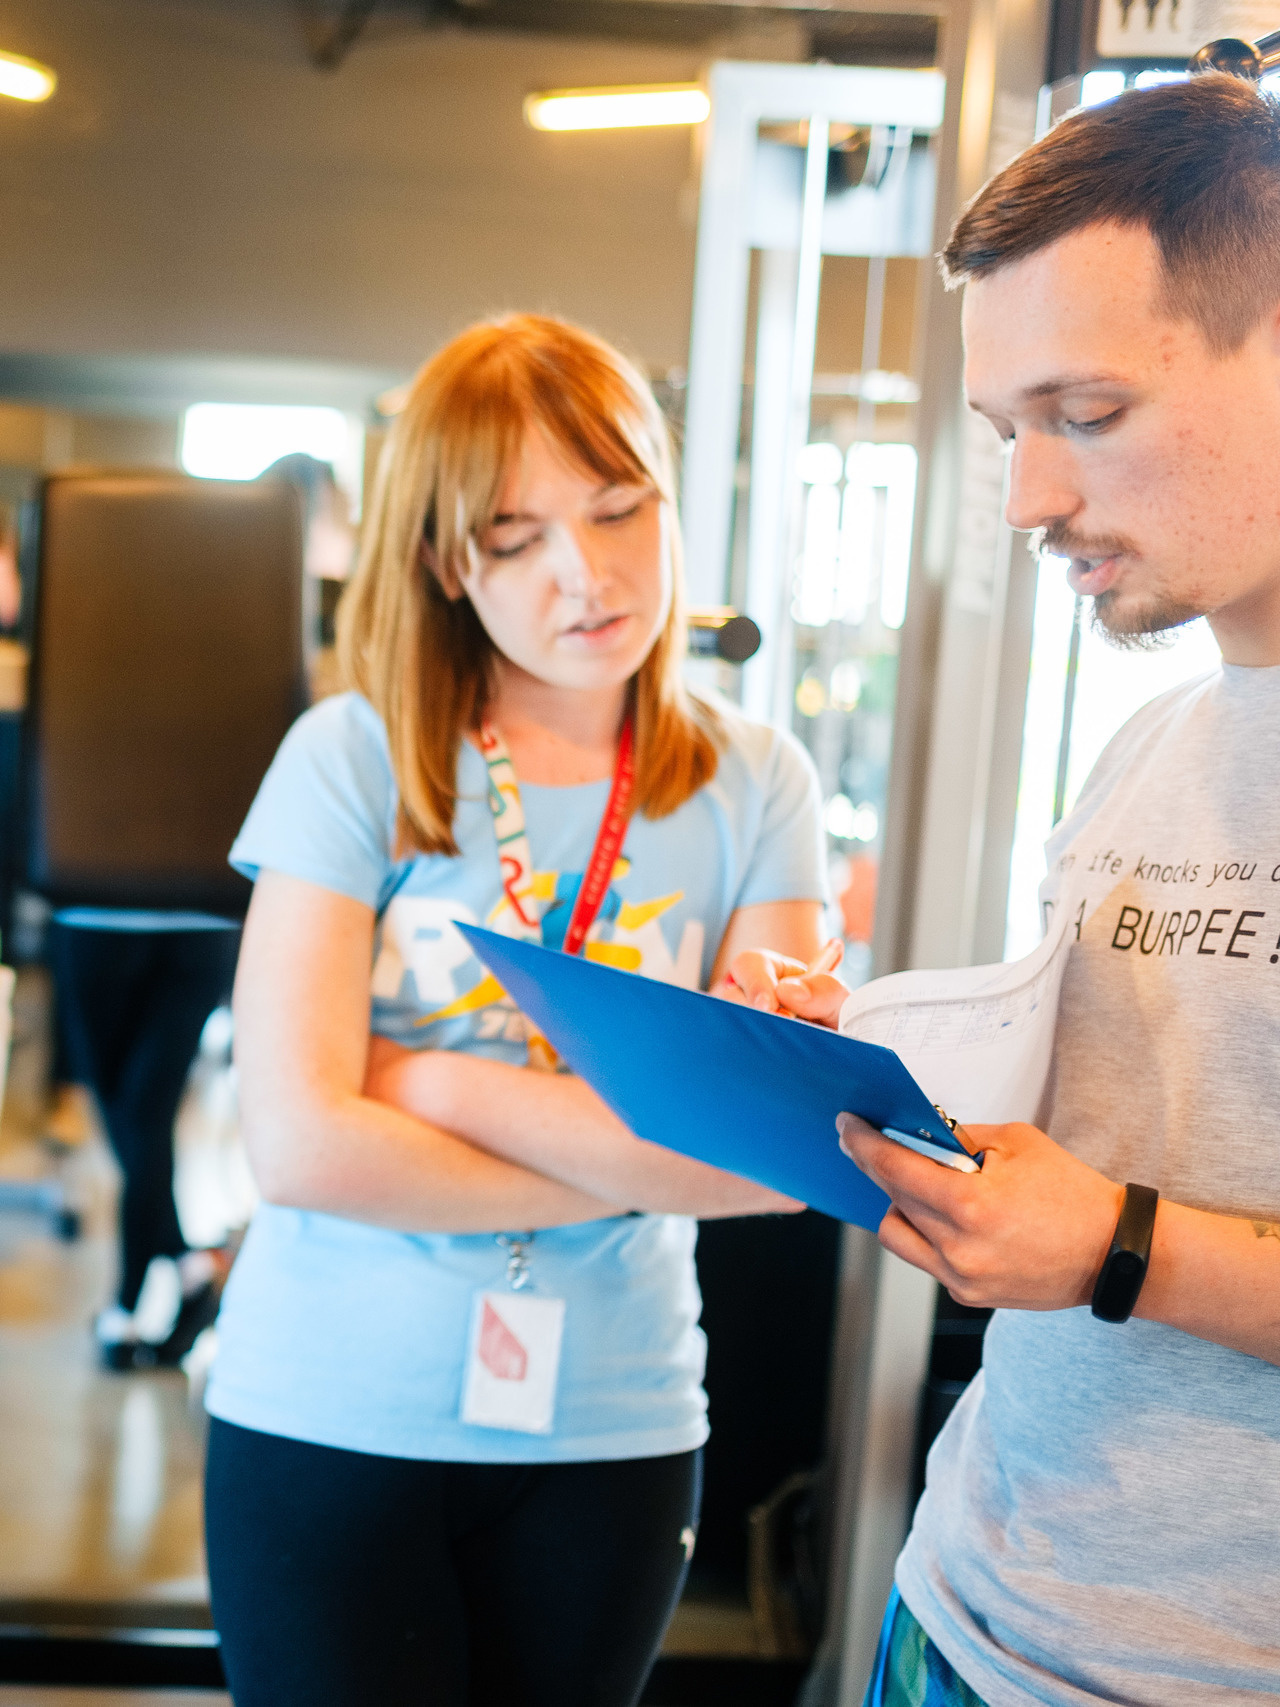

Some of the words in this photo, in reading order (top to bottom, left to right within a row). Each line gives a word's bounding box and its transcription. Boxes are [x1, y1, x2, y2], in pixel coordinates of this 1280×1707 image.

[1134, 855, 1200, 883] knocks
[1206, 863, 1257, 888] you
[1111, 905, 1280, 965] BURPEE!
